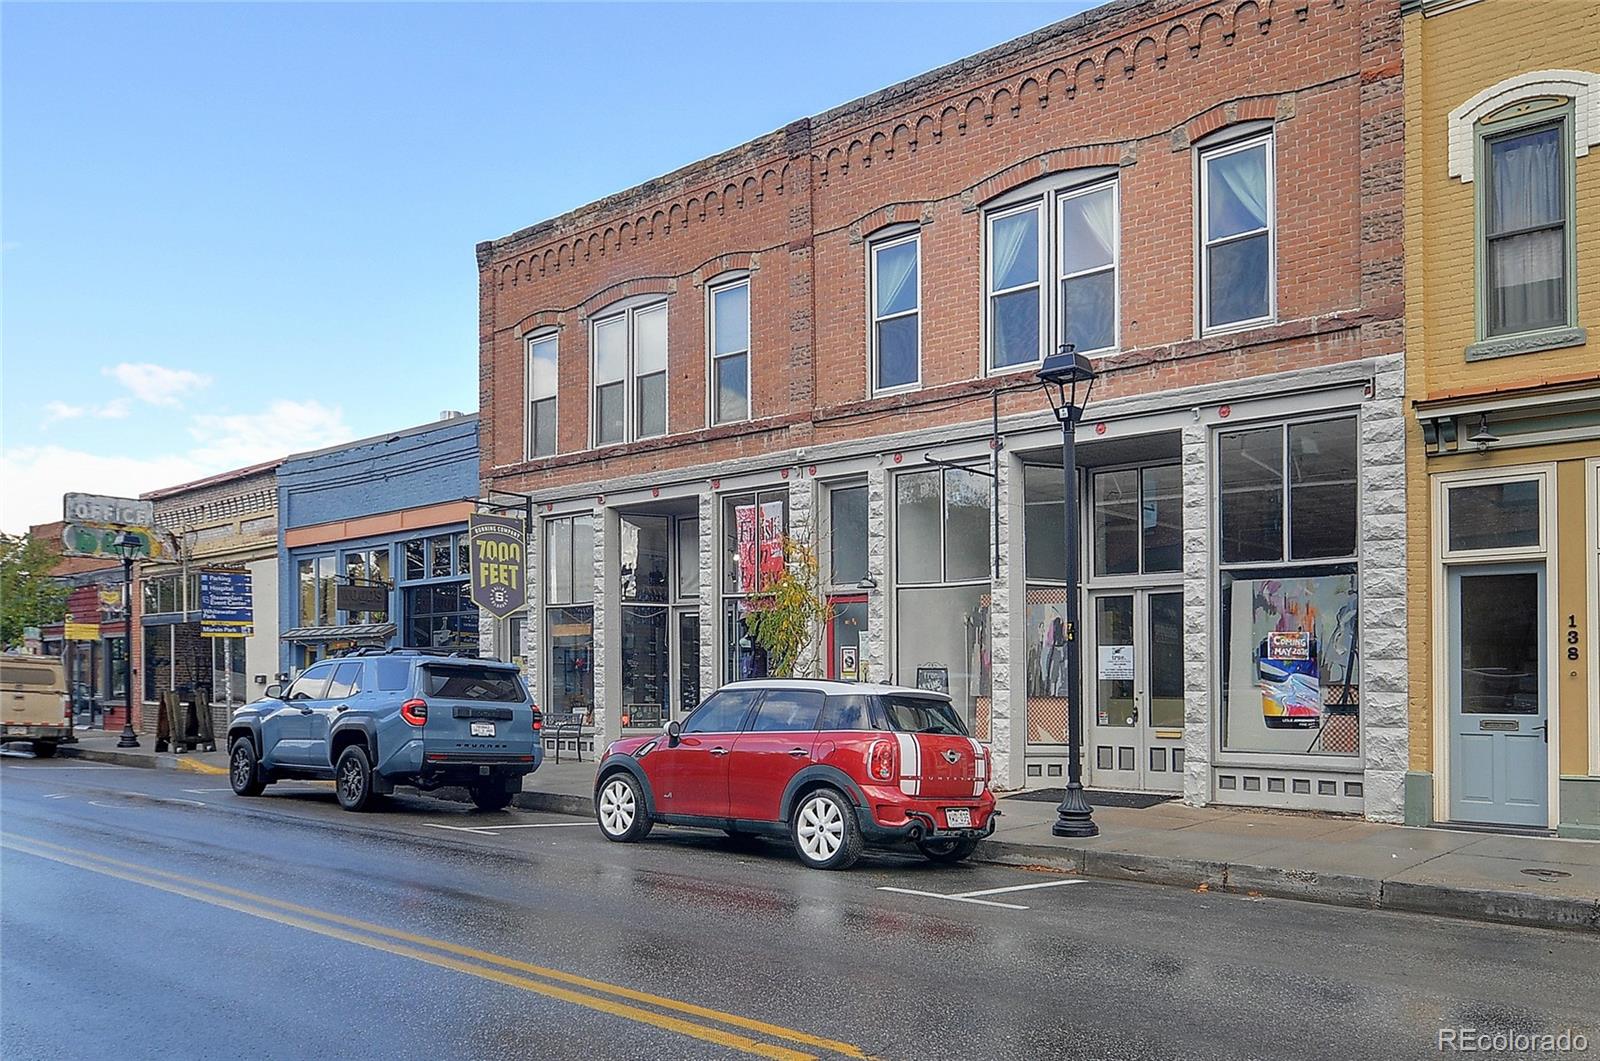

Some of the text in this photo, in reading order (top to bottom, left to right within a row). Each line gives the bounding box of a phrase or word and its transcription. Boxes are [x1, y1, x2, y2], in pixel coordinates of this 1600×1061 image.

[75, 503, 146, 523] OFFICE
[475, 525, 520, 538] RUNNING COMPANY
[477, 540, 520, 563] 7000
[480, 562, 519, 590] FEET
[1273, 635, 1306, 647] COMING
[1568, 614, 1579, 660] 138
[1275, 648, 1292, 656] MAY
